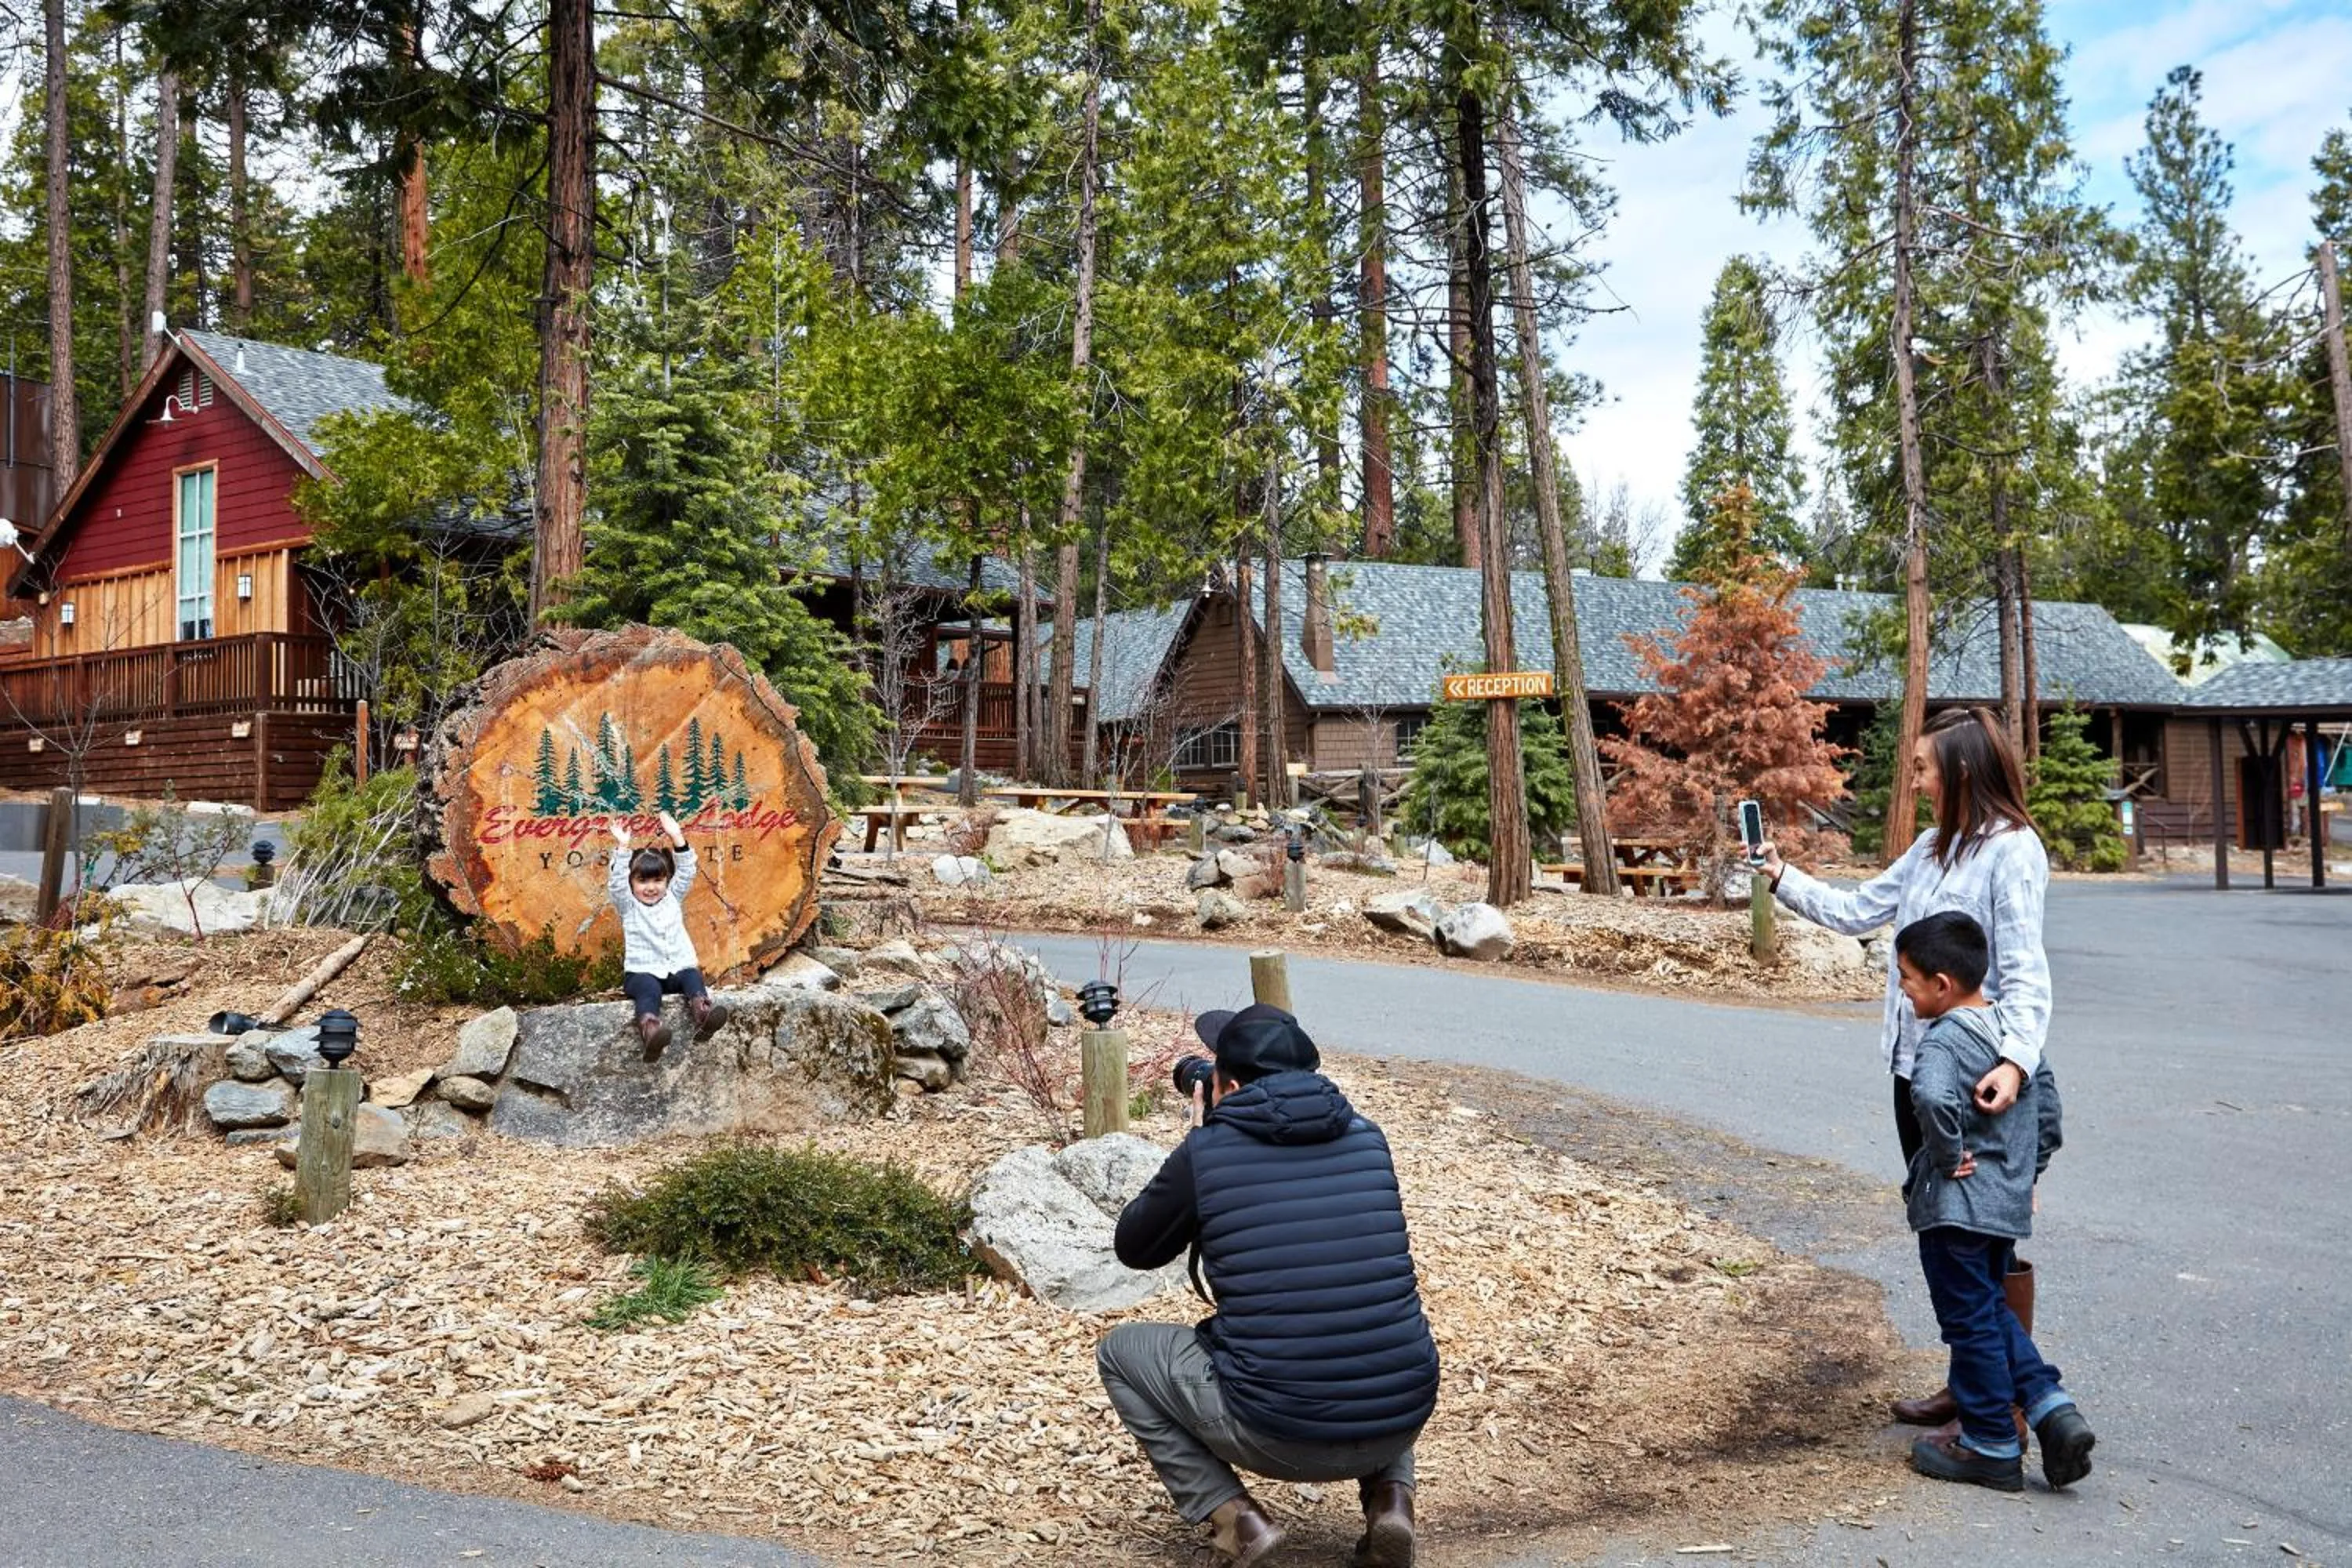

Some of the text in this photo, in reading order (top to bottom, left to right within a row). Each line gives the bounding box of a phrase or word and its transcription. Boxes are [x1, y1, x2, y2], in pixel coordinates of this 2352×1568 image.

[1467, 678, 1546, 696] RECEPTION
[679, 797, 797, 841] Lodge
[539, 844, 743, 869] YOSTE
